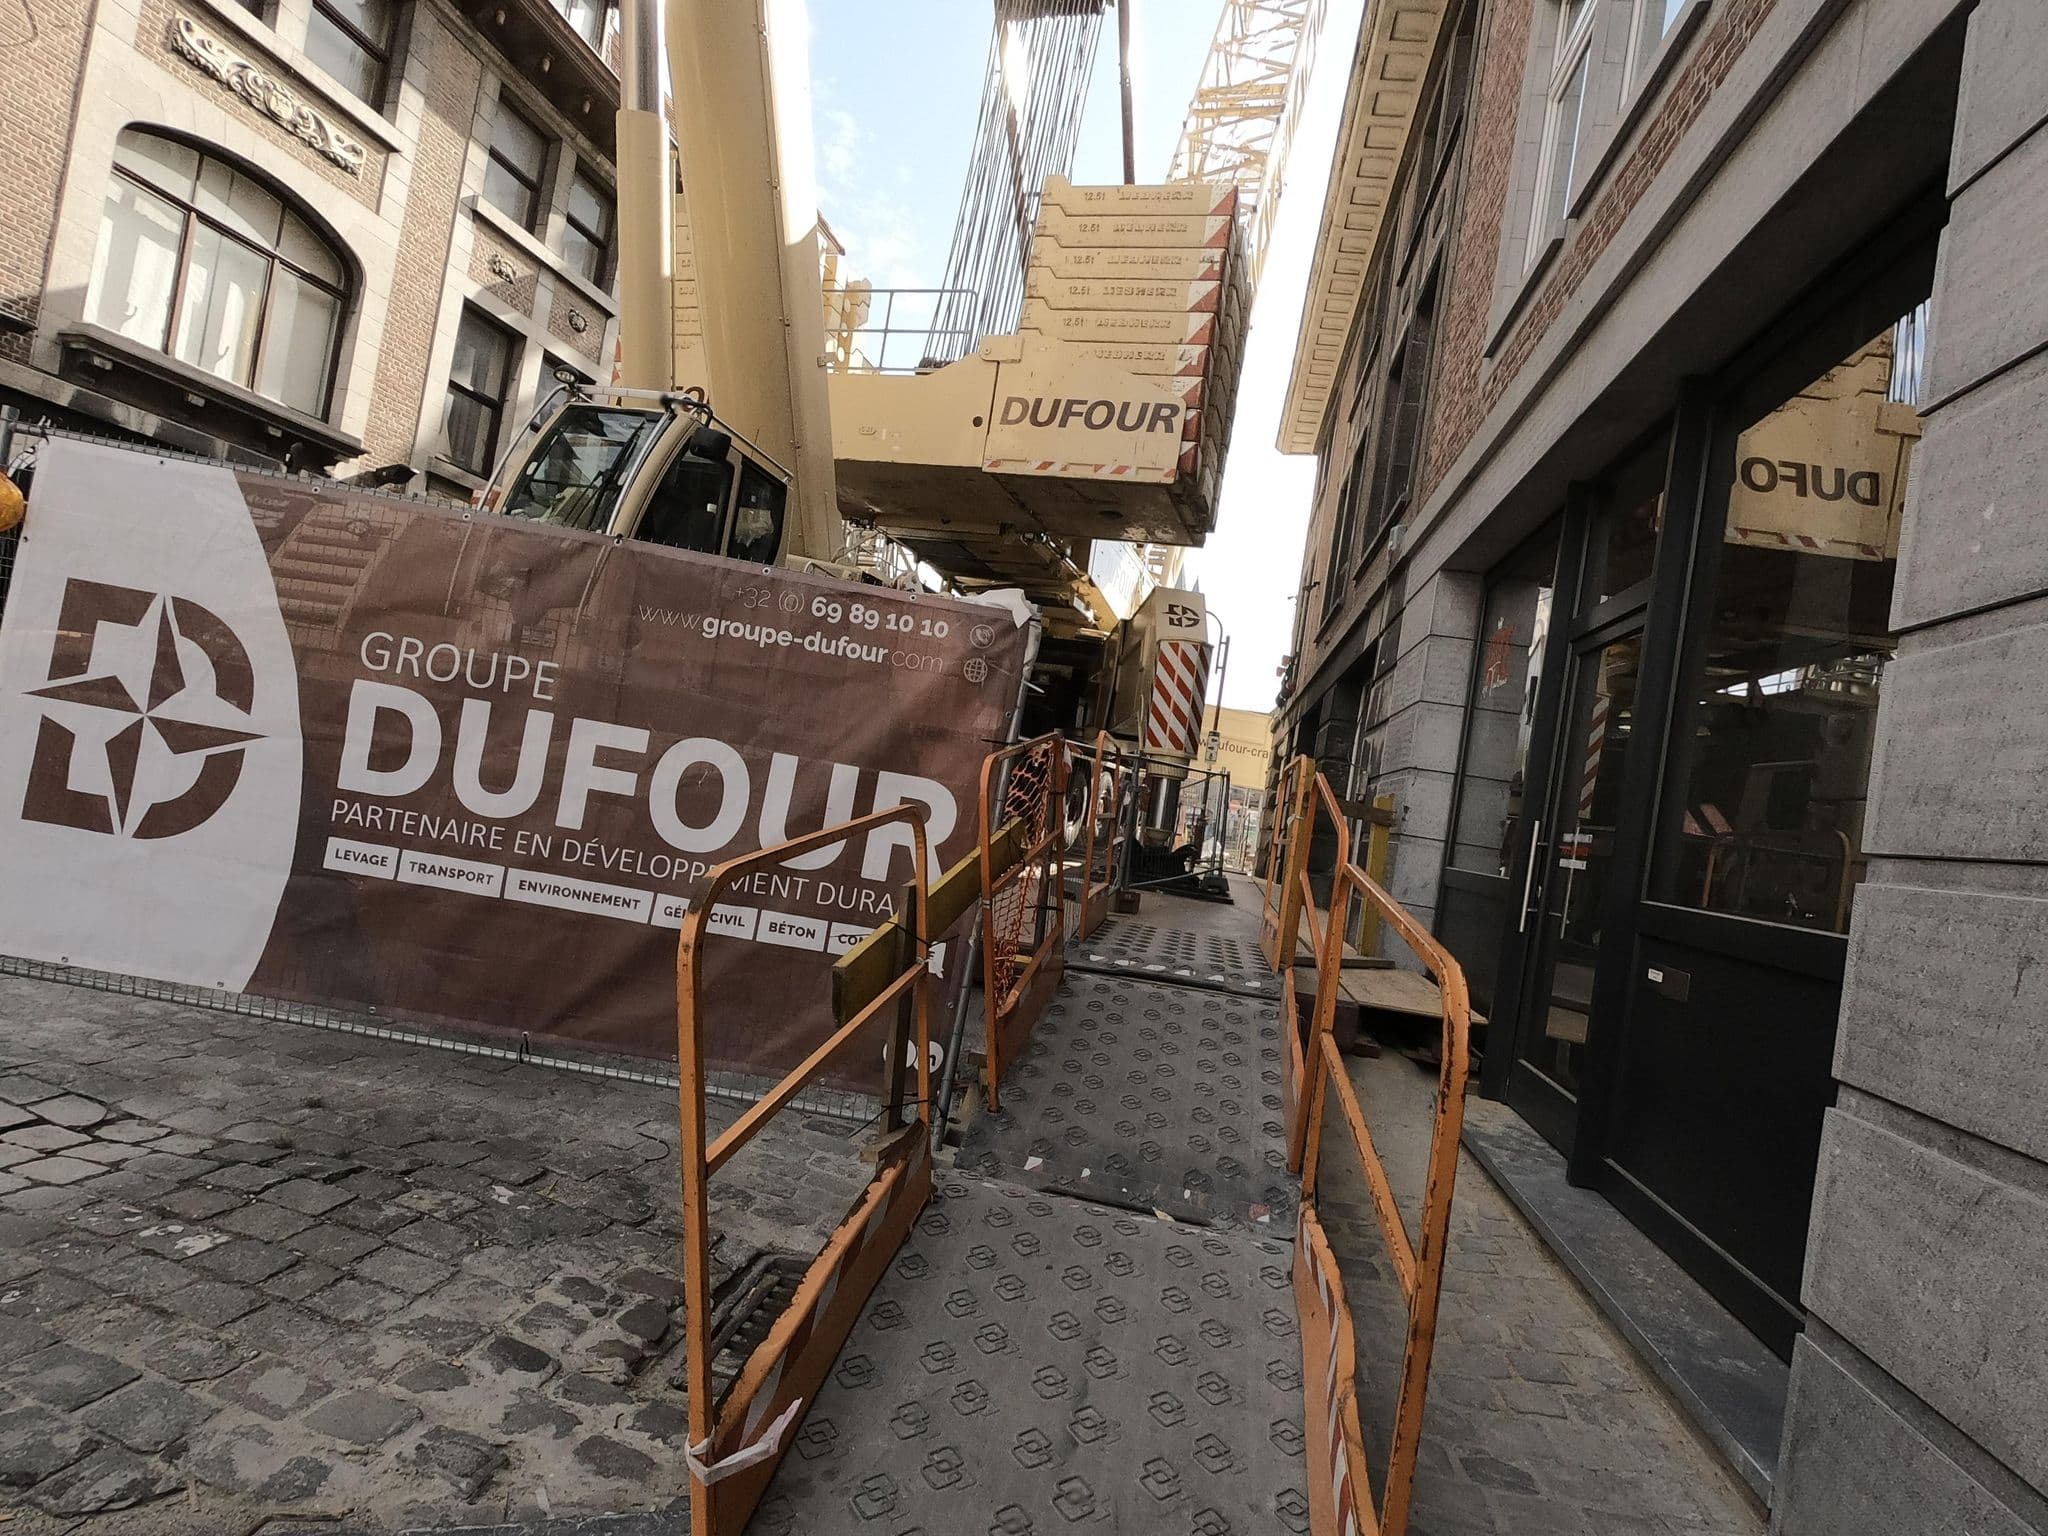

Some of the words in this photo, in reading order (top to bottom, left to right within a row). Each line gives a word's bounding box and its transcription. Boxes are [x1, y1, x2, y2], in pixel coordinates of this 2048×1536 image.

[999, 396, 1181, 434] DUFOUR
[736, 587, 772, 609] +32
[811, 596, 843, 624] 69
[849, 603, 880, 631] 89
[885, 613, 914, 633] 10
[920, 619, 949, 639] 10
[360, 631, 560, 701] GROUPE
[336, 678, 958, 886] DUFOUR
[330, 799, 506, 851] PARTENAIRE
[513, 830, 552, 859] EN
[561, 837, 810, 901] DÉVELOPPMENT
[334, 847, 389, 868] LEVAGE
[409, 860, 494, 886] TRANSPORT
[518, 879, 641, 911] ENVIRONNEMENT
[709, 911, 746, 927] CIVIL
[768, 919, 816, 940] BÉTON
